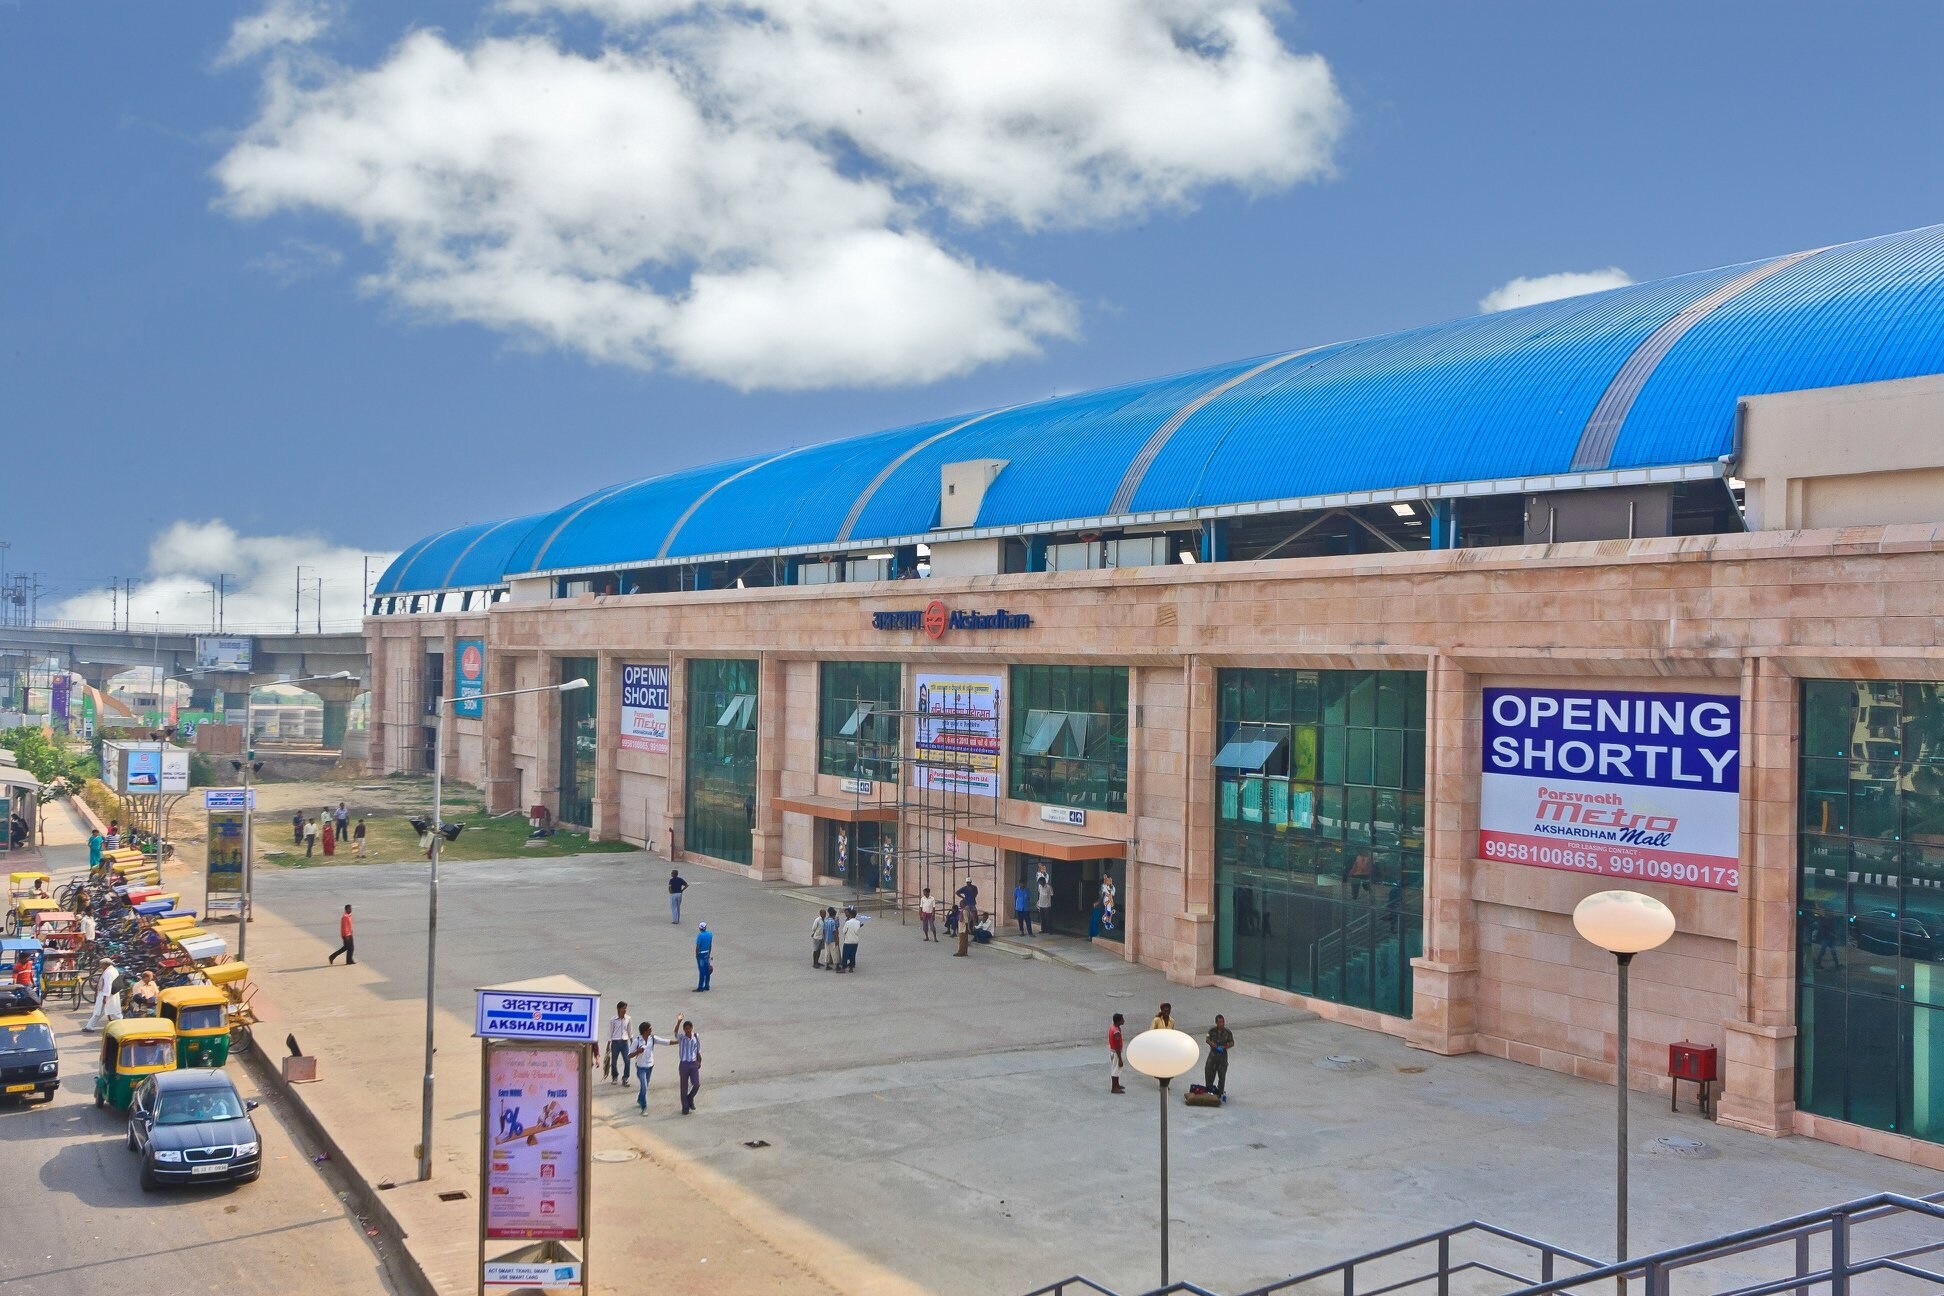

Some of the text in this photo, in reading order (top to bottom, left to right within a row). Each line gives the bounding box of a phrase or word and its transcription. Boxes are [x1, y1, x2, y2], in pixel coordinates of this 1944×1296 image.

[949, 609, 1030, 630] Akshardham
[624, 666, 668, 686] OPENIN
[624, 686, 669, 707] SHORTL
[1491, 694, 1732, 737] OPENING
[1491, 736, 1739, 784] SHORTLY
[1537, 786, 1623, 806] Parsvnath
[1534, 823, 1672, 848] AKSHARDHAM Mall
[1567, 841, 1580, 849] FOR
[1581, 843, 1607, 852] LEASING
[1485, 840, 1739, 887] 9958100865, 9910990173
[502, 999, 574, 1013] अक्षरधाम
[488, 1020, 585, 1033] AKSHARDHAM
[547, 1089, 557, 1098] Pay
